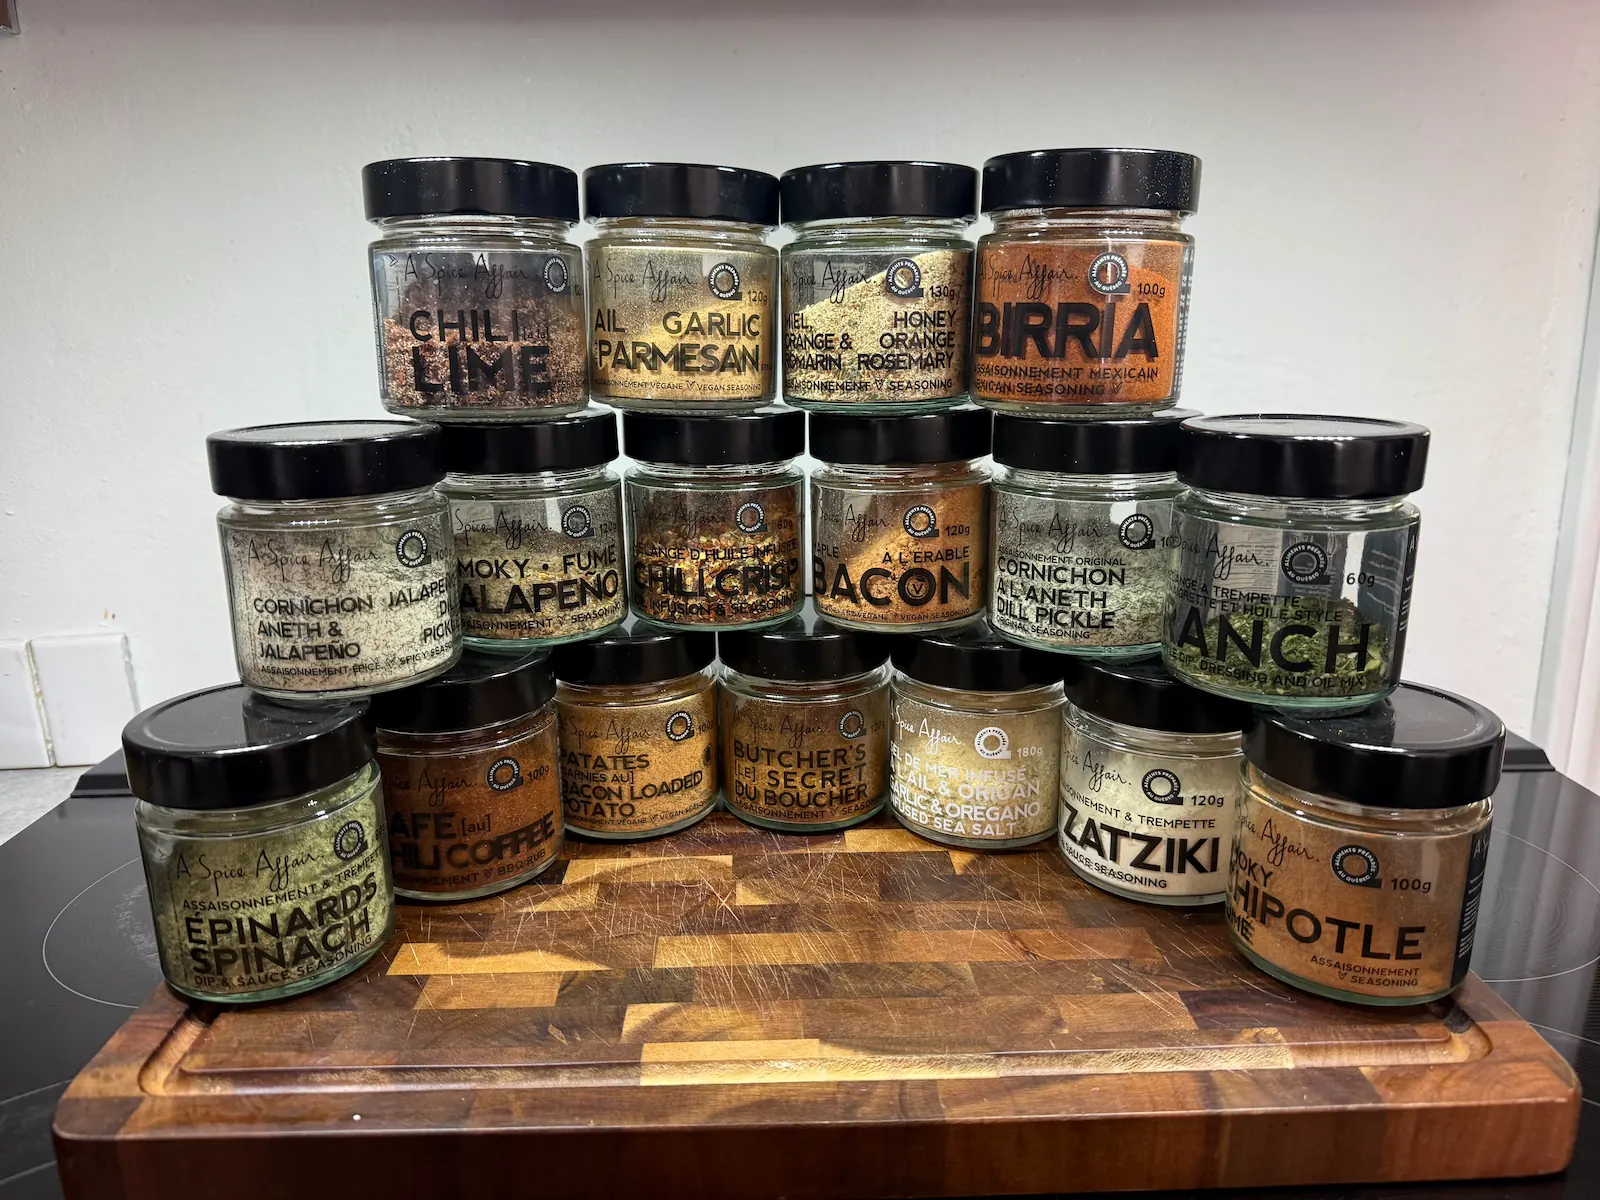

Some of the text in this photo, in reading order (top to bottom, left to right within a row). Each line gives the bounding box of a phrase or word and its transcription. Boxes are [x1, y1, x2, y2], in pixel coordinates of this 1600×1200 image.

[405, 254, 418, 282] A
[426, 253, 465, 296] Spice
[594, 260, 601, 284] A
[607, 258, 635, 298] Spice
[989, 254, 1012, 297] Spice
[748, 291, 767, 305] 120g
[930, 286, 955, 299] 130g
[1137, 283, 1166, 298] 100g
[410, 310, 519, 341] CHILI
[595, 309, 760, 337] AIL GARLIC
[894, 310, 956, 327] HONEY
[786, 333, 852, 349] ORANGE &
[880, 332, 955, 349] ORANGE
[977, 303, 1159, 359] BIRRIA
[599, 340, 759, 372] PARMESAN
[858, 353, 955, 370] ROSEMARY
[412, 346, 552, 392] LIME
[1090, 367, 1158, 379] MEXICAIN
[698, 383, 760, 391] VEGAN SEASONING
[889, 379, 952, 391] SEASONING
[1017, 383, 1105, 395] SEASONING
[455, 508, 487, 546] Spice
[945, 525, 970, 536] 120g
[1013, 507, 1041, 546] Spice
[249, 540, 260, 563] A
[267, 539, 310, 583] Spice
[1284, 545, 1305, 567] ALIMENTS
[458, 558, 530, 578] MOKY
[715, 558, 798, 596] CRISP
[998, 556, 1125, 585] CORNICHON
[460, 569, 618, 613] ALAPEÑO
[814, 555, 970, 606] BACON
[1346, 572, 1375, 588] 60g
[254, 595, 374, 614] CORNICHON
[1213, 585, 1300, 607] TREMPETTE
[571, 602, 621, 623] SEASONING
[931, 608, 970, 620] SEASONING
[997, 597, 1114, 628] DILL PICKLE
[1221, 601, 1344, 623] ET HUILE STYLE
[258, 622, 343, 638] ANETH &
[997, 615, 1090, 639] ORIGINAL SEASONING
[260, 641, 361, 660] JALAPEÑO
[1176, 606, 1370, 673] ANCH
[400, 651, 428, 665] SPICY
[261, 665, 348, 676] ASSAISONNEMENT
[1200, 660, 1364, 688] DRESSING AND OIL MIX
[569, 716, 600, 749] Spice
[896, 704, 915, 740] Spice
[560, 751, 649, 770] PATATES
[734, 739, 866, 768] BUTCHER'S
[1017, 746, 1043, 758] 180g
[528, 765, 549, 781] 100g
[768, 762, 866, 788] SECRET
[905, 753, 1026, 782] DE MER INFUSÉ
[562, 771, 703, 800] BACON LOADED
[735, 780, 868, 808] DU BOUCHER
[938, 781, 951, 796] &
[958, 780, 1040, 801] ORIGAN
[563, 795, 635, 817] POTATO
[734, 799, 825, 819] ASSAISONNEMENT
[890, 775, 1040, 822] GARLIC & OREGANO
[1191, 795, 1224, 807] 120g
[660, 811, 683, 820] VEGAN
[934, 817, 966, 834] SEA
[972, 822, 1016, 836] SALT
[1125, 812, 1216, 829] & TREMPETTE
[447, 810, 554, 868] COFFEE
[1063, 800, 1220, 874] ZATZIKI
[498, 849, 546, 876] BBQ RUB
[1335, 847, 1357, 867] ALIMENTS
[176, 854, 191, 879] A
[200, 854, 245, 896] Spice
[1094, 862, 1167, 889] SEASONING
[1390, 877, 1431, 894] 100g
[183, 880, 331, 911] ASSAISONNEMENT &
[185, 872, 377, 945] ÉPINARDS
[1232, 875, 1425, 960] HIPOTLE
[192, 906, 371, 975] SPINACH
[195, 934, 372, 987] DIP & SAUCE SEASONING
[1310, 955, 1420, 977] ASSAISONNEMENT
[1350, 975, 1418, 987] SEASONING
